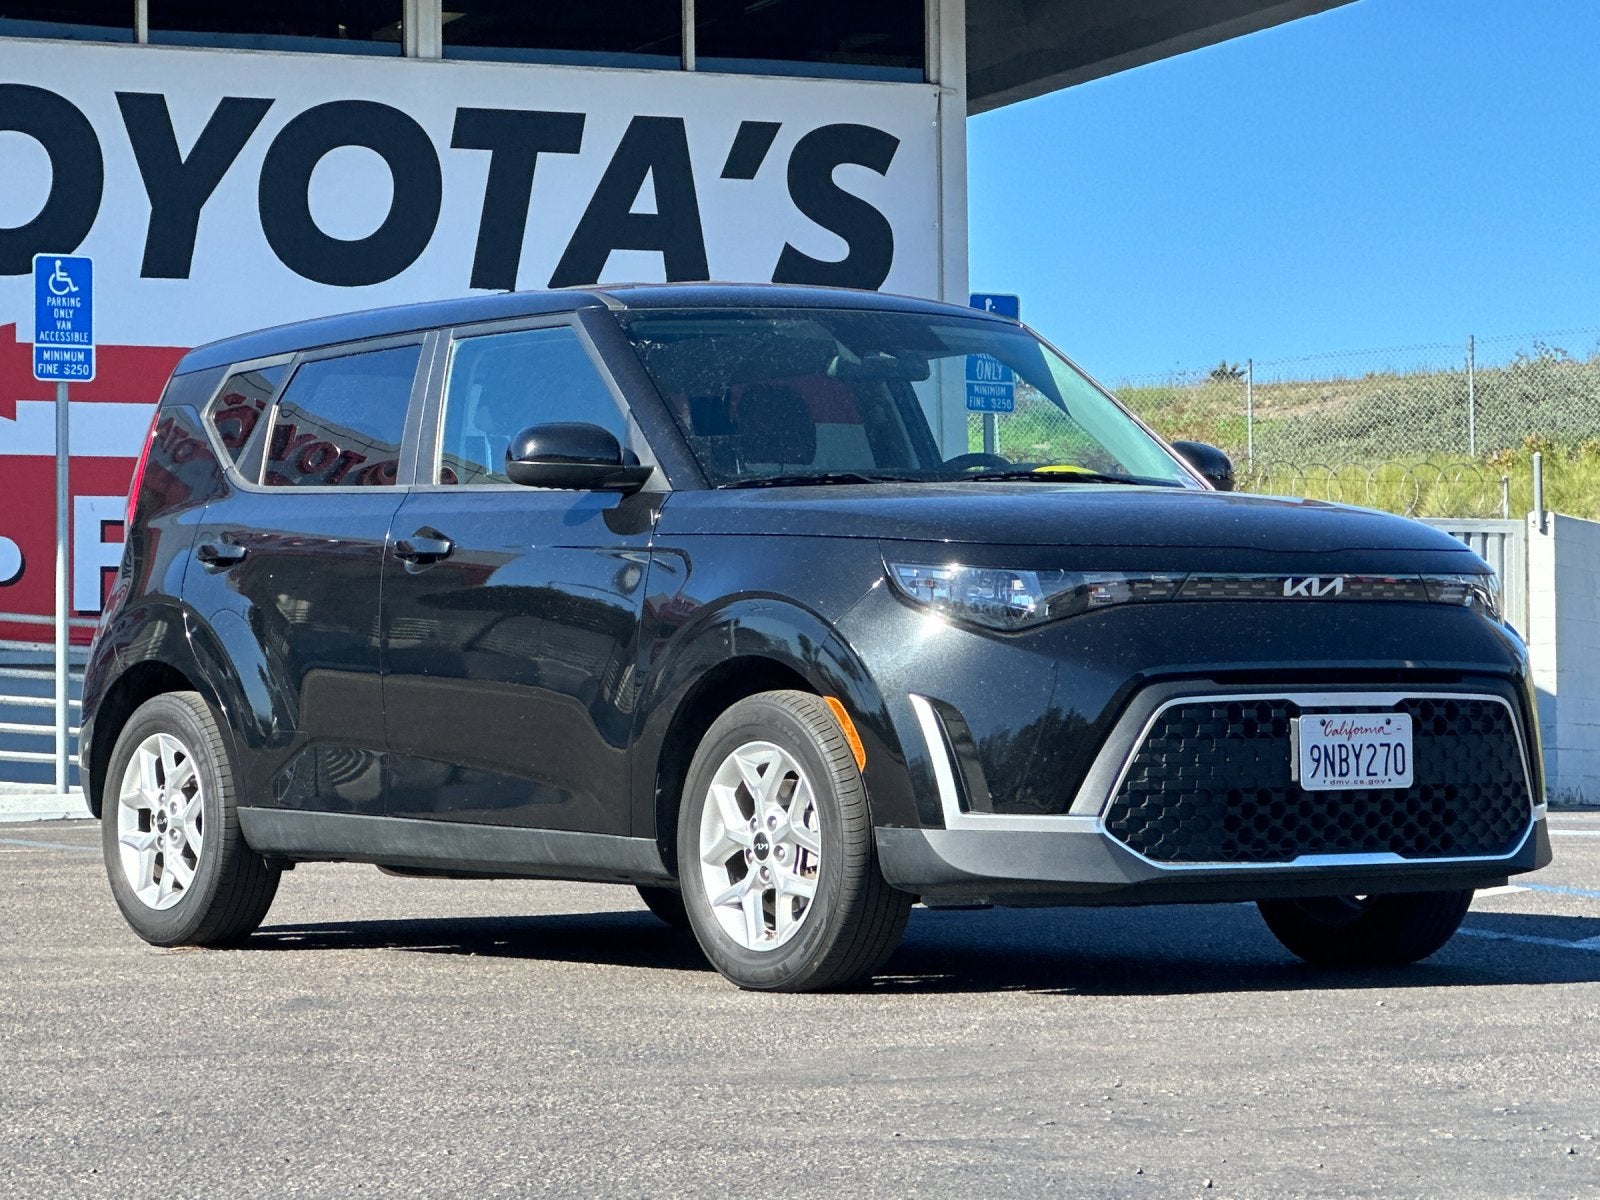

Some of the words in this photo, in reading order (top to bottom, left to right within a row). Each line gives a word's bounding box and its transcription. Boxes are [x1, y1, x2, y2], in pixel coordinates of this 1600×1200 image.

[46, 297, 81, 308] PARKING
[53, 308, 74, 319] ONLY
[56, 320, 72, 331] VAN
[39, 331, 89, 342] ACCESSIBLE
[43, 349, 85, 362] MINIMUM
[37, 363, 59, 374] FINE
[63, 364, 89, 375] $250
[976, 360, 1003, 380] ONLY
[973, 385, 1006, 397] MINIMUM
[969, 396, 985, 408] FINE
[1283, 577, 1344, 597] KIA
[1323, 719, 1392, 741] California
[1309, 742, 1406, 779] 9NBY270
[1329, 778, 1387, 786] dmv.ca.gov
